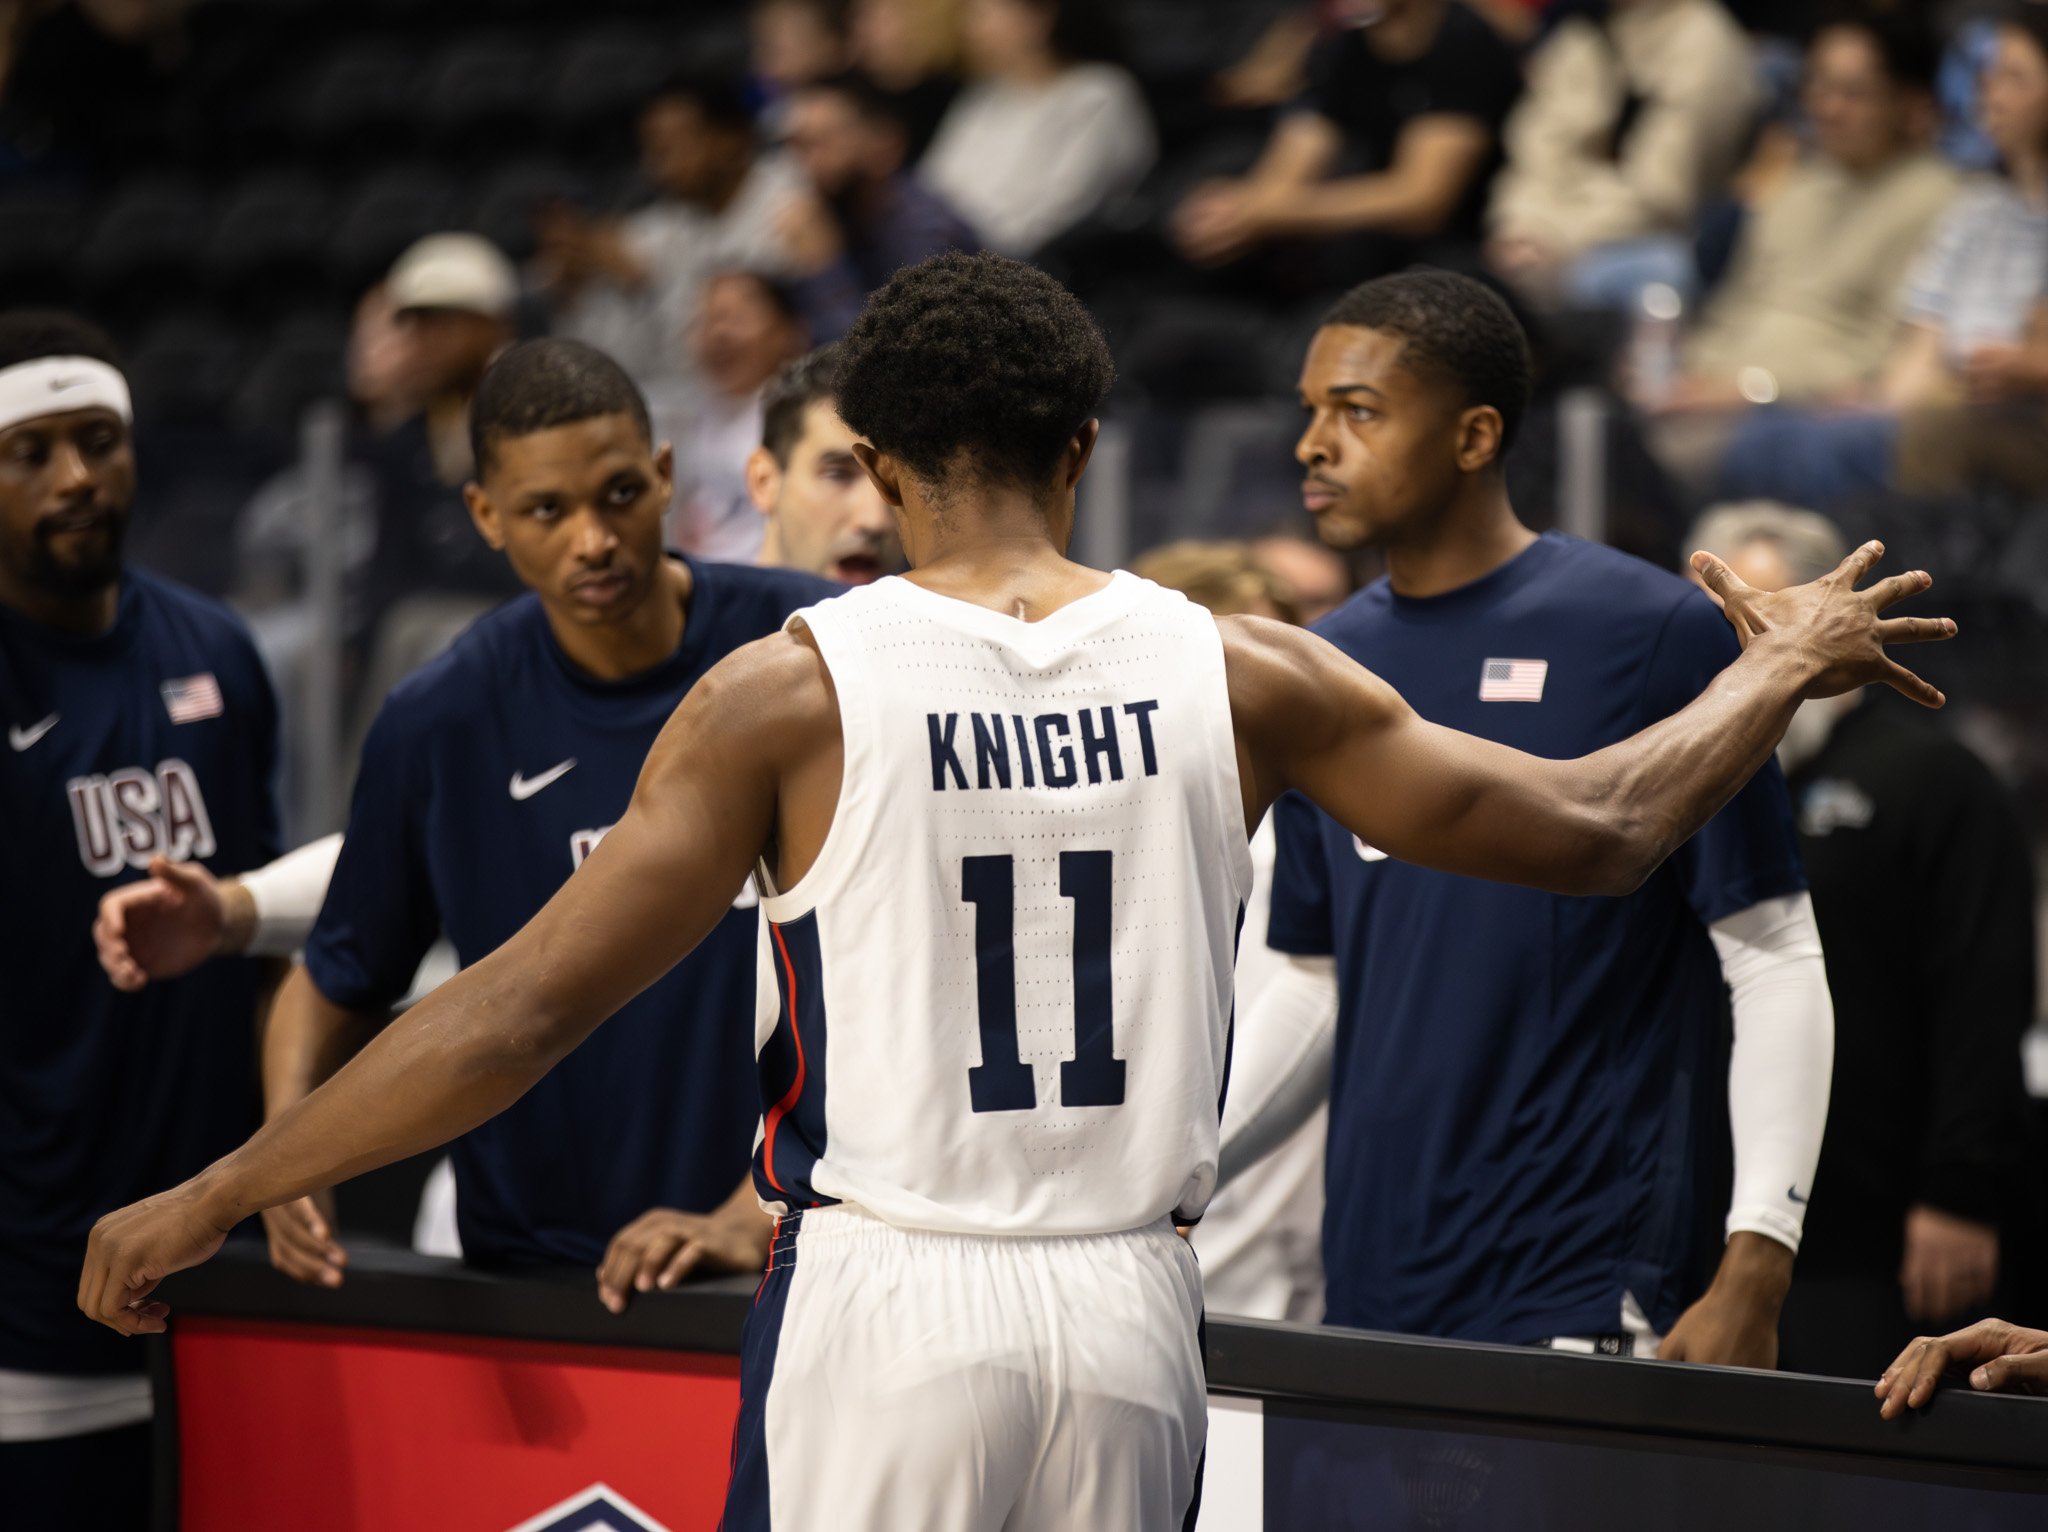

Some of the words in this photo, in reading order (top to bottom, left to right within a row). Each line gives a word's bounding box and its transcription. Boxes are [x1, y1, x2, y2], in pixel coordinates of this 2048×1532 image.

[927, 699, 1159, 791] KNIGHT
[66, 758, 217, 877] USA
[961, 850, 1126, 1113] 11
